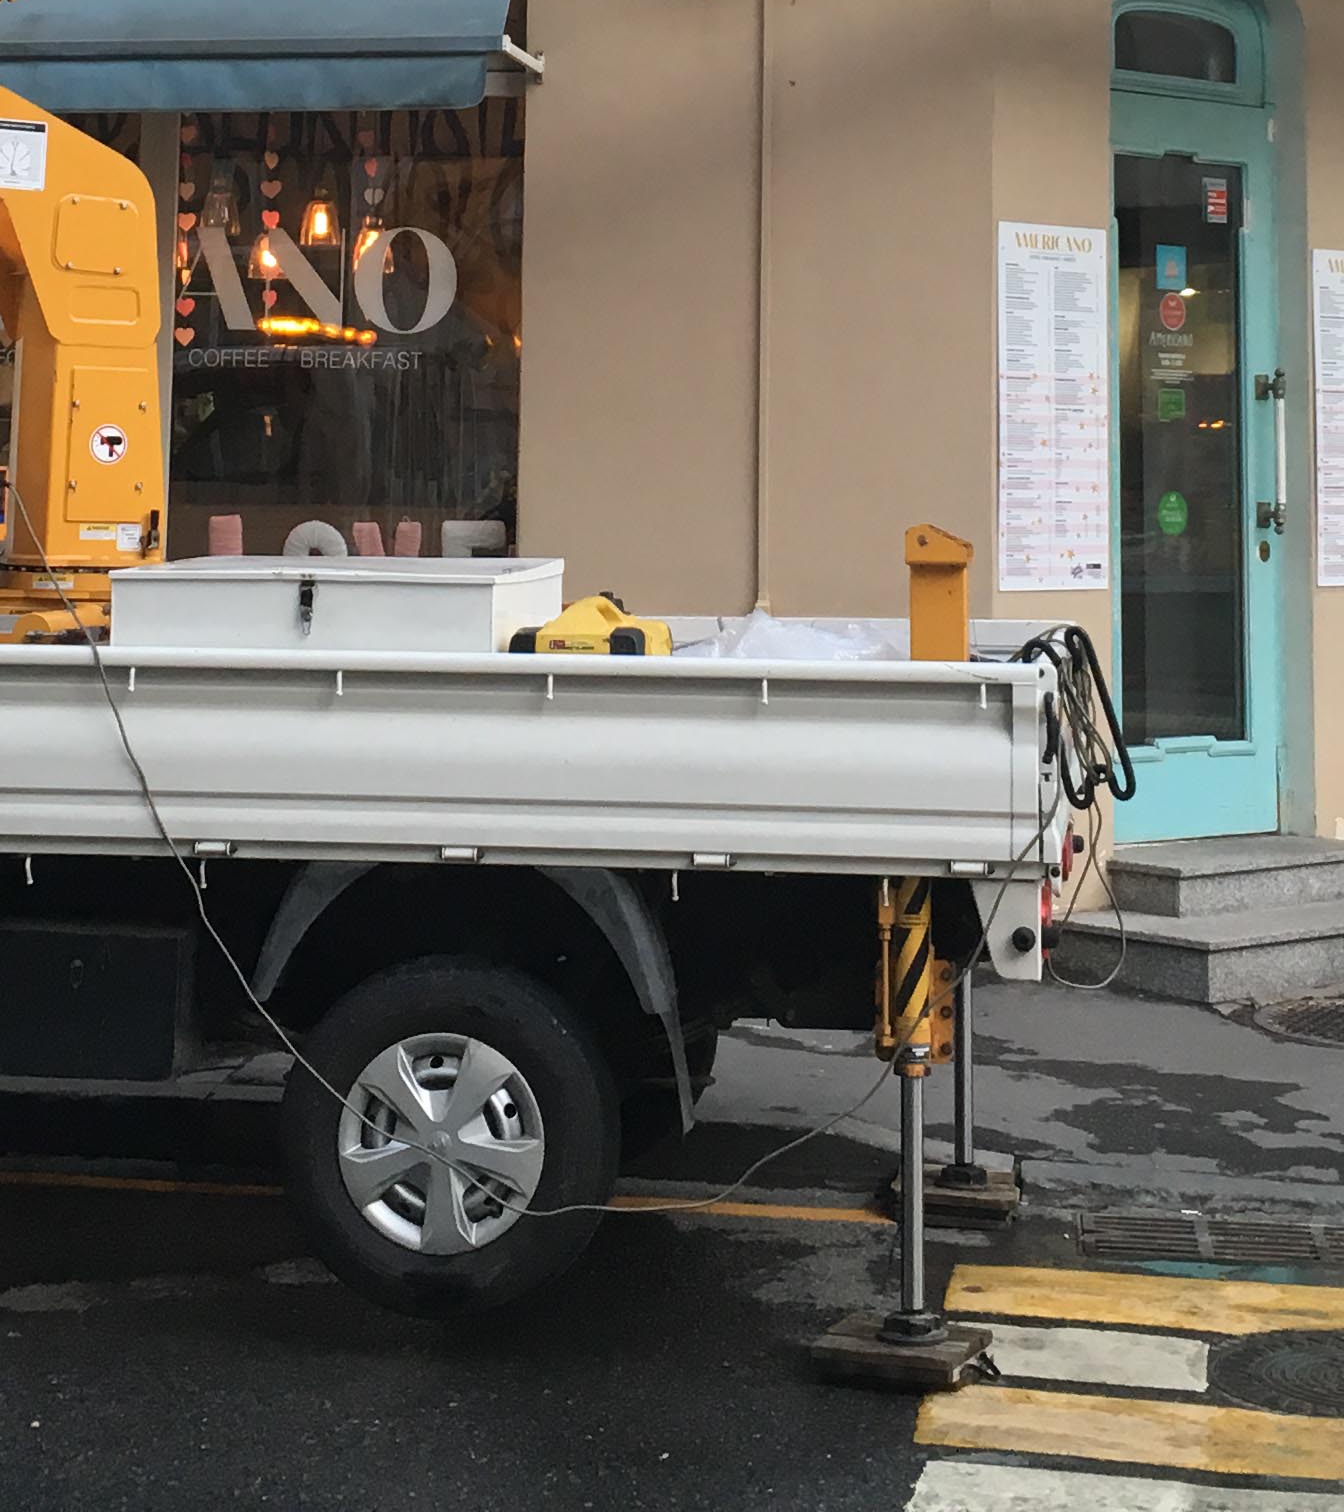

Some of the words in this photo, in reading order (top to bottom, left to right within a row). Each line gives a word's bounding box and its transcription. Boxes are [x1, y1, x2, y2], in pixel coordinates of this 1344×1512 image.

[1014, 231, 1093, 253] AMERICANO
[188, 348, 270, 368] COFFEE
[300, 350, 423, 371] BREAKFAST
